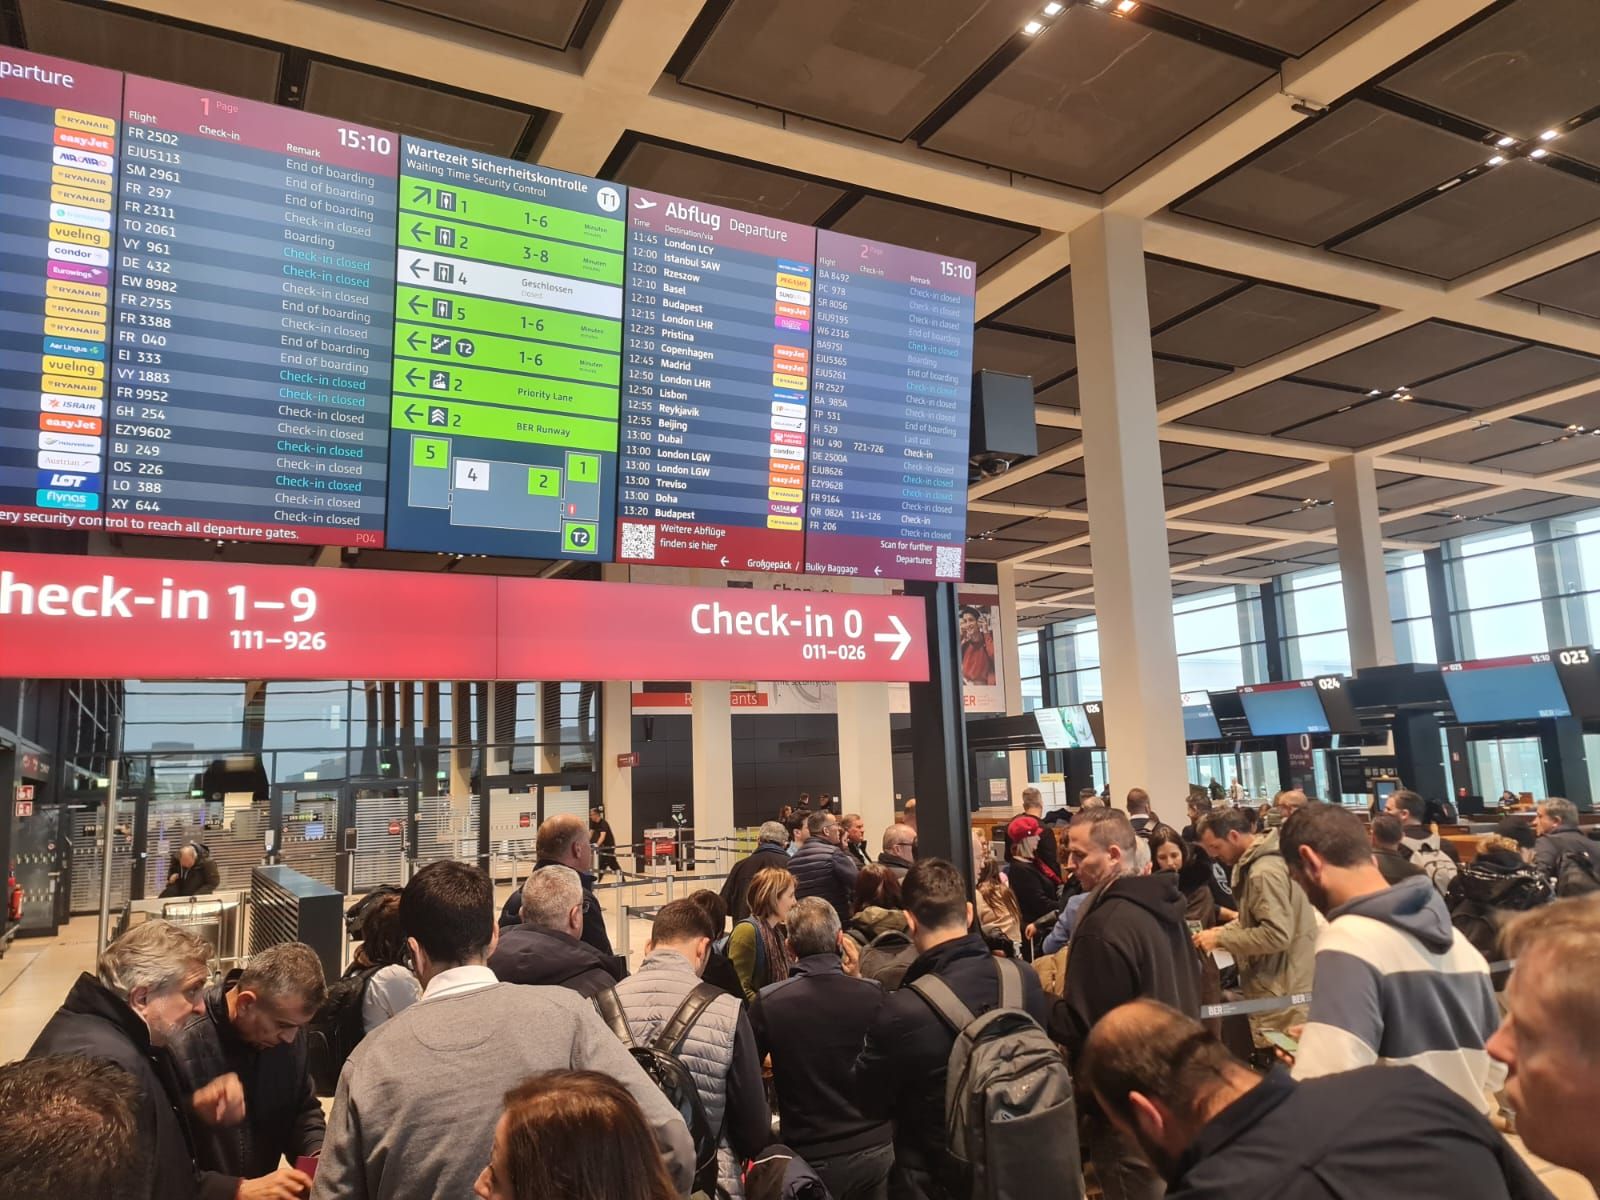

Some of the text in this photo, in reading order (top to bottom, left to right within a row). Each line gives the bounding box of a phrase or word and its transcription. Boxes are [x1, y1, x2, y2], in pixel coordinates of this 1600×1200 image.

[0, 61, 74, 88] parture
[200, 98, 239, 116] 1 Page
[67, 117, 109, 129] RYANAIR
[129, 110, 157, 124] Flight
[128, 127, 178, 146] FR 2502
[199, 125, 240, 141] Check-in
[60, 134, 109, 149] easyJet
[338, 128, 390, 155] 15:10
[128, 145, 180, 164] EJU5113
[286, 143, 320, 157] Remark
[126, 164, 180, 183] SM 2961
[286, 158, 375, 187] End of boarding
[407, 143, 588, 193] Wartezeit Sicherheitskontrolle
[63, 172, 107, 187] RYANAIR
[406, 158, 546, 197] Waiting Time Security Control
[126, 182, 172, 199] FR 297
[601, 192, 615, 207] T1
[125, 200, 175, 219] FR 2311
[461, 200, 548, 228] 1 1-6
[124, 219, 176, 237] TO 2061
[284, 211, 372, 237] Check-in closed
[665, 202, 788, 242] Abflug Departure
[55, 226, 101, 244] vueling
[284, 229, 335, 249] Boarding
[665, 223, 714, 241] Destination/via
[123, 237, 170, 255] VY 961
[460, 236, 549, 263] 2 3-8
[634, 232, 714, 255] 11:45 London LCY
[54, 247, 92, 258] condor
[283, 247, 370, 271] Check-in closed
[664, 253, 720, 271] Istanbul SAW
[53, 266, 92, 279] Eurowings
[664, 268, 700, 282] Rzeszow
[940, 261, 972, 279] 15:10
[122, 275, 177, 293] EW 8982
[458, 272, 573, 295] 4 Geschlossen
[632, 277, 686, 295] 12:10 Basel
[121, 293, 172, 310] FR 2755
[662, 298, 703, 313] Budapest
[457, 308, 544, 332] 5 1-6
[817, 312, 848, 324] EJU9195
[119, 331, 166, 346] FR 040
[662, 328, 694, 341] Pristina
[49, 343, 88, 354] Aer Lingus
[458, 341, 543, 366] T2 1-6
[661, 344, 714, 359] Copenhagen
[118, 350, 161, 364] EI 333
[661, 359, 691, 371] Madrid
[117, 368, 170, 384] VY 1883
[454, 378, 573, 402] 2 Priority Lane
[629, 385, 687, 400] 12:50 Lisbon
[63, 401, 96, 411] ISRAIR
[116, 405, 165, 420] 6H 254
[659, 403, 700, 417] Reykjavik
[115, 424, 171, 439] EZY9602
[453, 414, 570, 437] 2 BER Runway
[659, 419, 688, 432] Beijing
[658, 434, 683, 444] Dubai
[426, 445, 435, 460] 5
[658, 449, 711, 462] London LGW
[854, 443, 932, 459] 721-726 Check-in
[467, 468, 478, 482] 4
[580, 461, 586, 474] 1
[50, 474, 86, 487] LOT
[113, 480, 162, 494] LO 388
[539, 474, 548, 488] 2
[656, 478, 687, 489] Treviso
[46, 491, 86, 503] flynas
[656, 493, 678, 504] Doha
[112, 498, 160, 512] XY 644
[624, 506, 695, 520] 13:20 Budapest
[0, 511, 21, 524] ery
[23, 512, 76, 527] security
[131, 518, 144, 529] to
[148, 519, 182, 532] reach
[186, 521, 200, 532] all
[203, 522, 262, 537] departure
[266, 527, 299, 540] gates.
[660, 524, 726, 538] Weitere Abflüge
[356, 533, 376, 543] P04
[573, 531, 588, 544] T2
[660, 538, 717, 551] finden sie hier
[880, 540, 933, 552] Scan for further
[748, 558, 858, 575] Großgepäck / Bulky Baggage
[896, 554, 933, 565] Departures
[0, 571, 317, 622] heck-in 1–9
[691, 602, 862, 638] Check-in 0
[230, 630, 326, 650] 111–926
[802, 644, 866, 660] 011–026
[1560, 650, 1589, 665] 023
[1319, 678, 1340, 690] 024
[963, 696, 976, 706] ER
[1086, 704, 1100, 713] 026
[1292, 994, 1305, 1004] BER
[1208, 1006, 1222, 1015] BER
